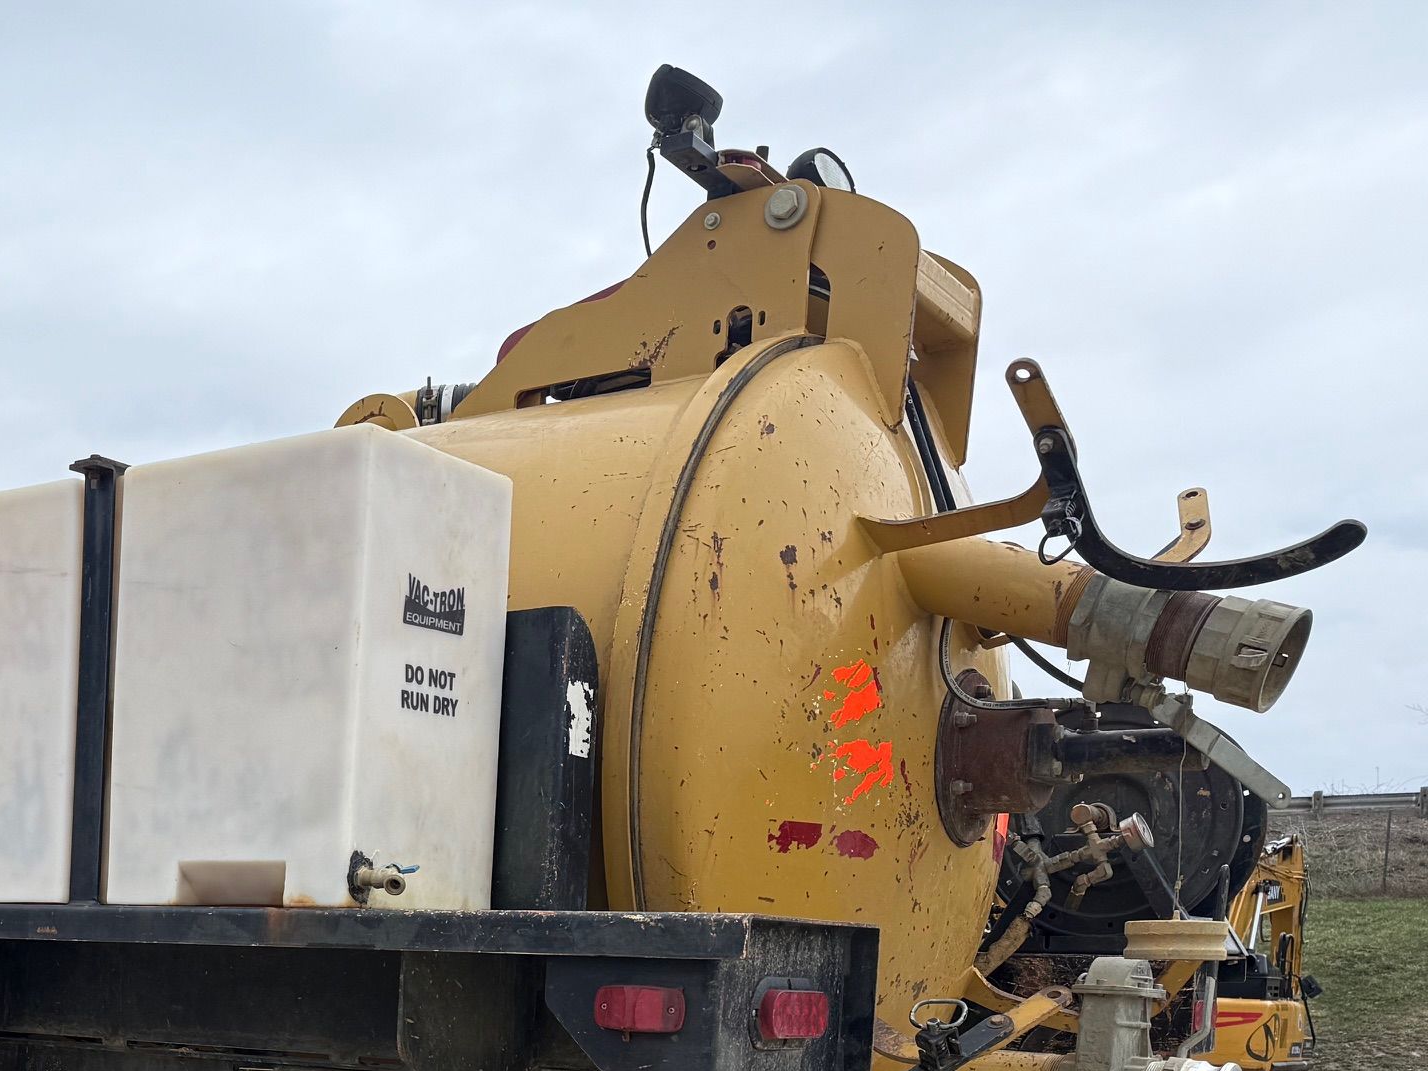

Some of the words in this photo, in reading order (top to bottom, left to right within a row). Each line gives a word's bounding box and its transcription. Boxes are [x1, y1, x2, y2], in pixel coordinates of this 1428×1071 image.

[408, 572, 465, 613] VAC-TRON
[405, 611, 462, 633] EQUIPMENT
[405, 663, 424, 686] DO
[428, 668, 456, 691] NOT
[401, 689, 429, 713] RUN
[433, 695, 459, 717] DRY
